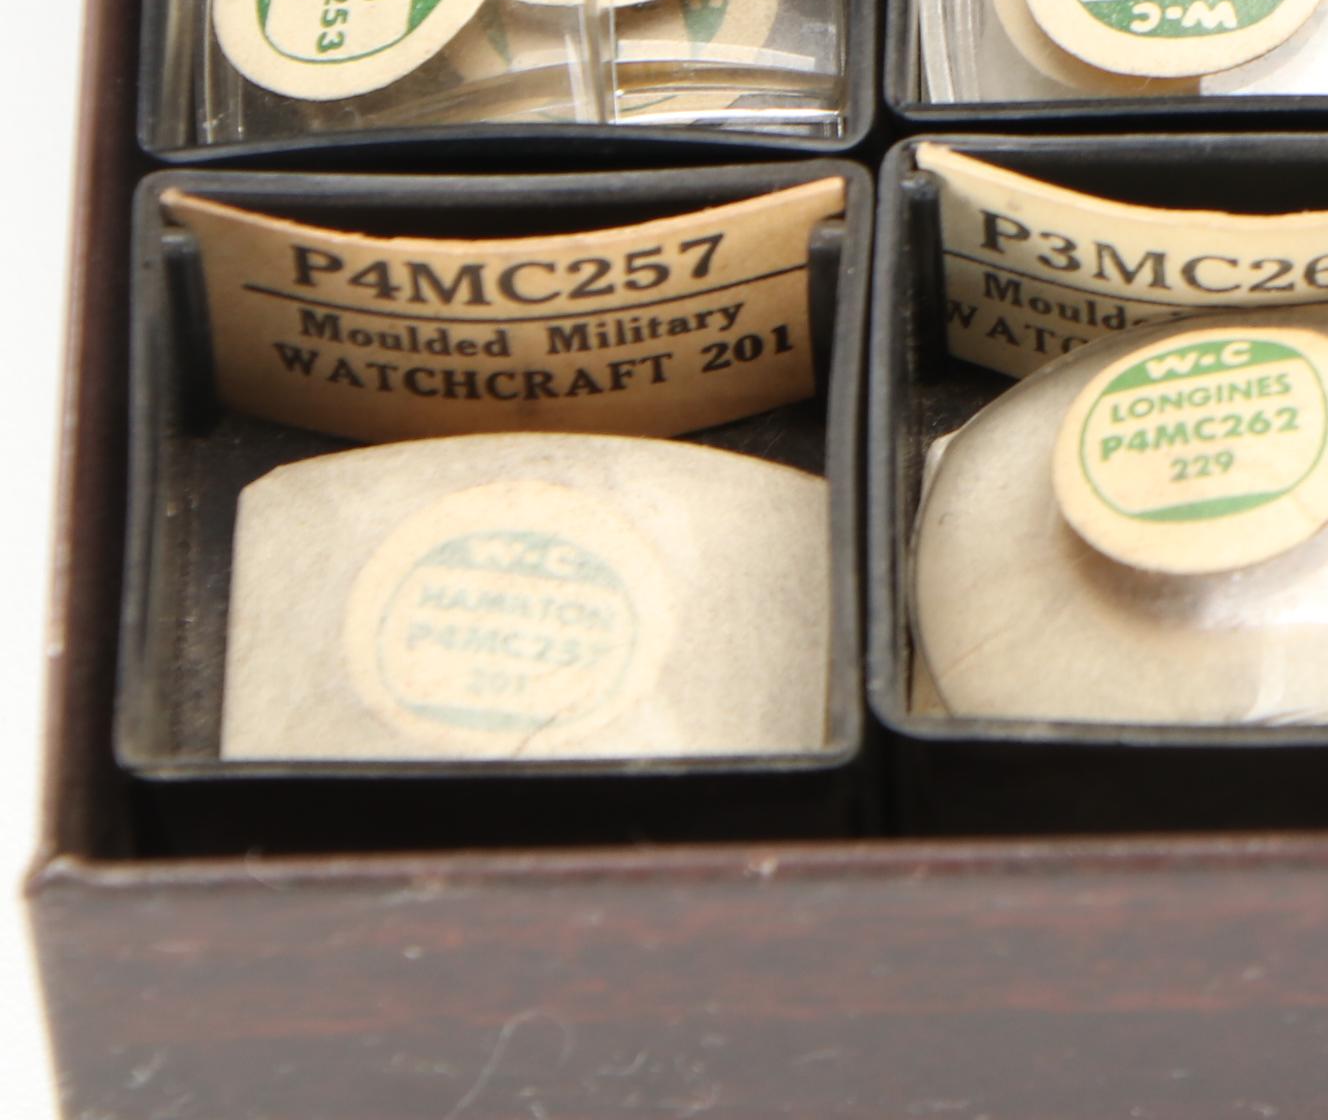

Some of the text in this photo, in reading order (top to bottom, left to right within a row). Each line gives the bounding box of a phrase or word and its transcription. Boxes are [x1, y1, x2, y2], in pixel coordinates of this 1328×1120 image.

[290, 233, 726, 309] P4MC257
[300, 301, 745, 357] Moulded Military
[979, 272, 1143, 331] Mould
[273, 324, 796, 401] WATCHCRAFT 201
[1111, 373, 1292, 423] LONGINES
[1100, 407, 1300, 461] P4MC262
[1170, 450, 1234, 482] 229
